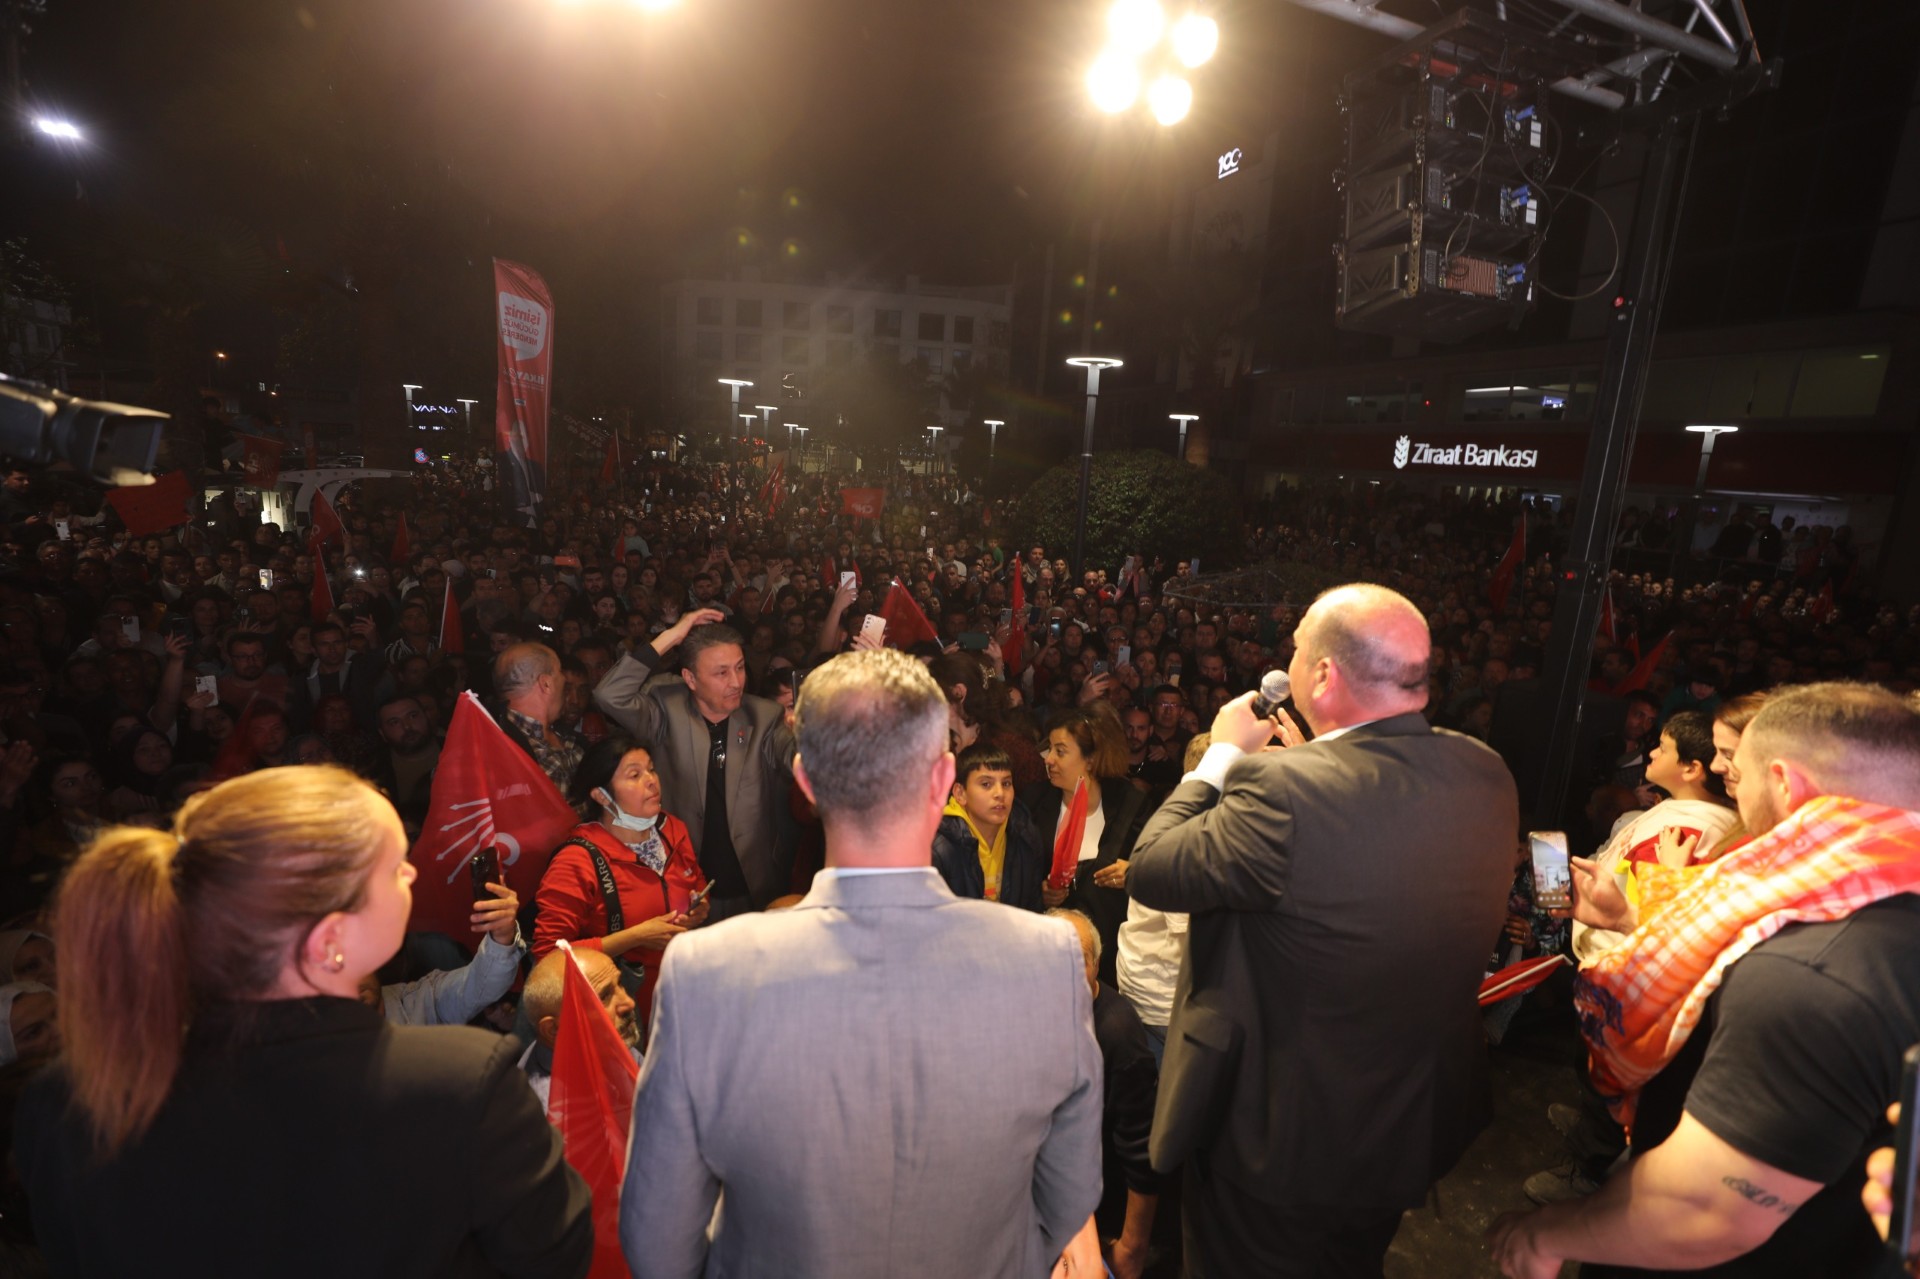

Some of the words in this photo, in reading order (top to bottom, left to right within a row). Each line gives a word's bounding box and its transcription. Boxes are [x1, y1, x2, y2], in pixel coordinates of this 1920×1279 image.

[1411, 443, 1462, 465] Ziraat
[1464, 443, 1537, 467] Bankası
[597, 857, 614, 893] MARC
[611, 913, 620, 930] BS
